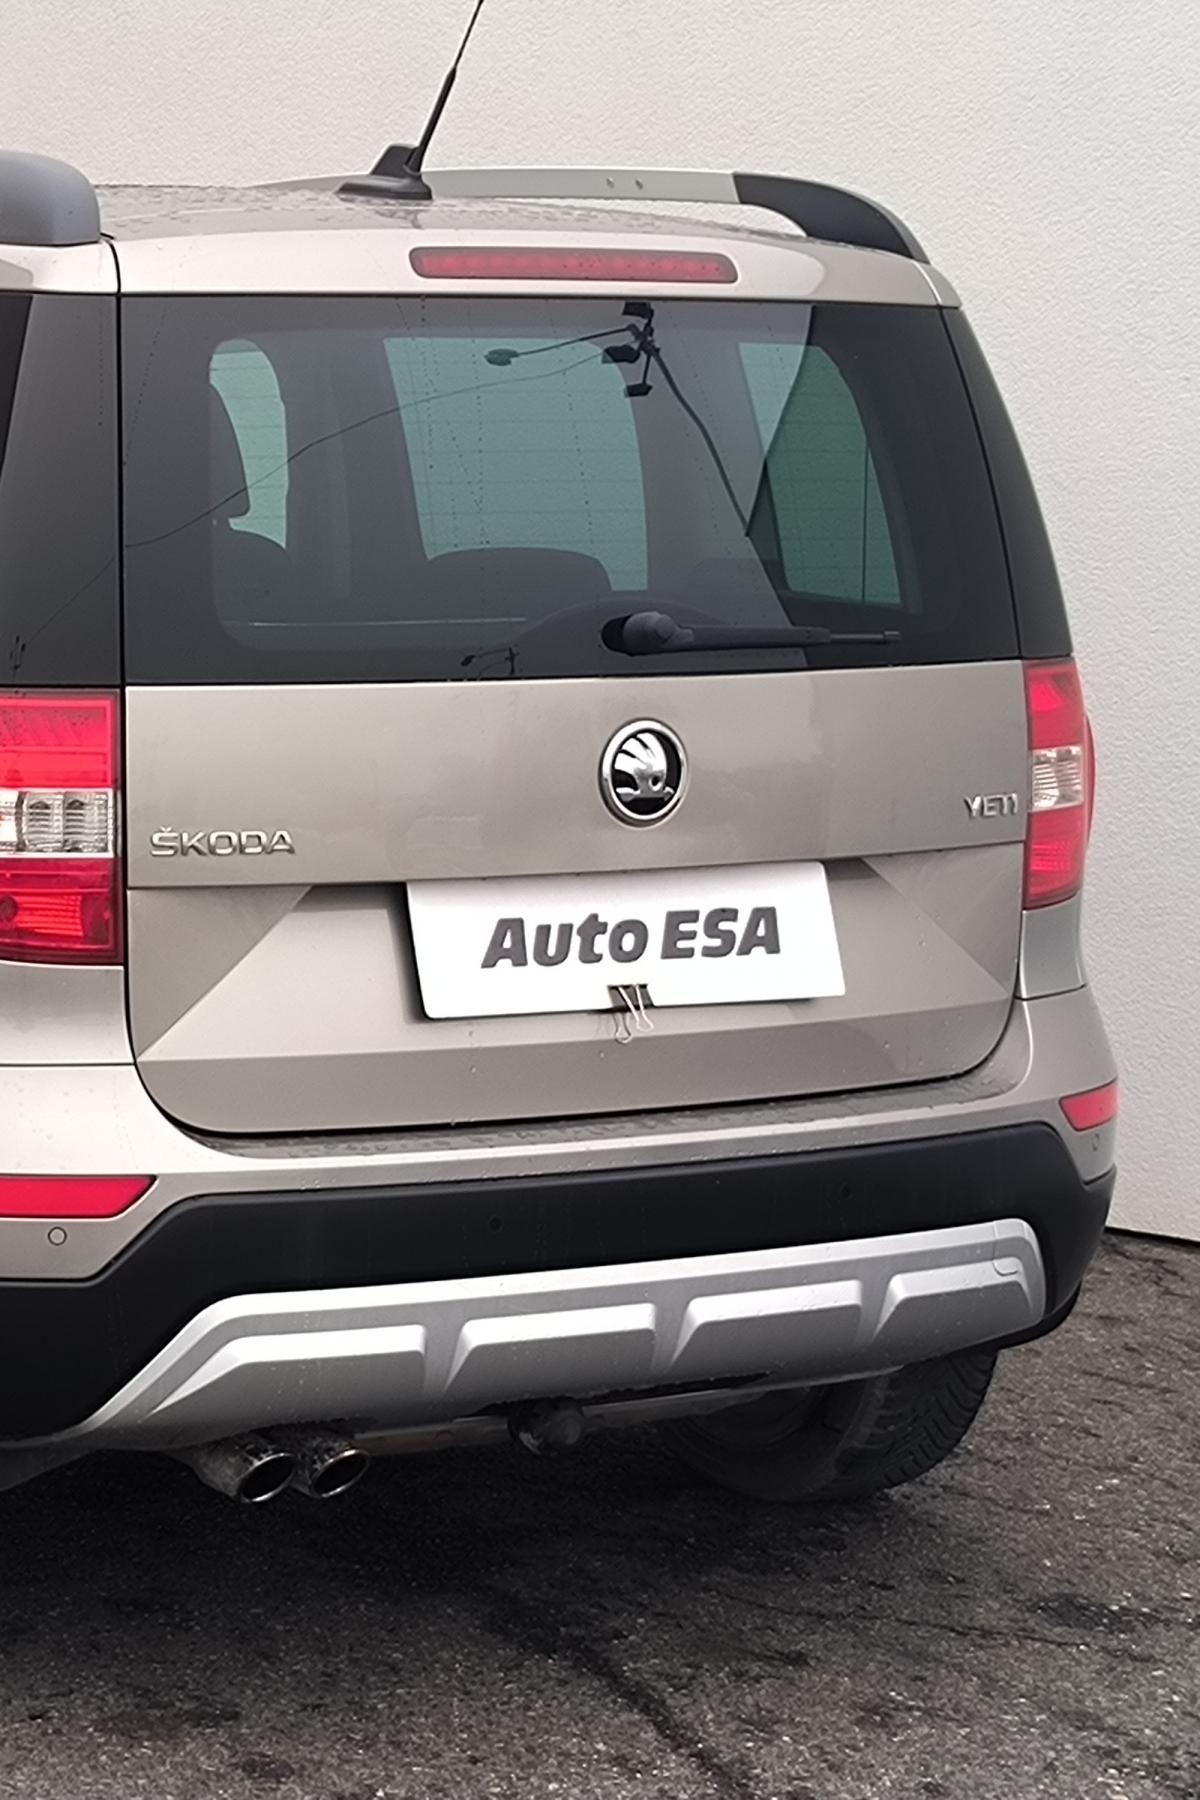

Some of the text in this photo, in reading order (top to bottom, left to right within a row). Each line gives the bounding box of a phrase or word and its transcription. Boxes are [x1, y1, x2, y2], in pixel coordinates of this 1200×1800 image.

[964, 792, 1018, 818] YETI
[150, 827, 296, 857] ŠKODA
[481, 906, 781, 968] Auto ESA
